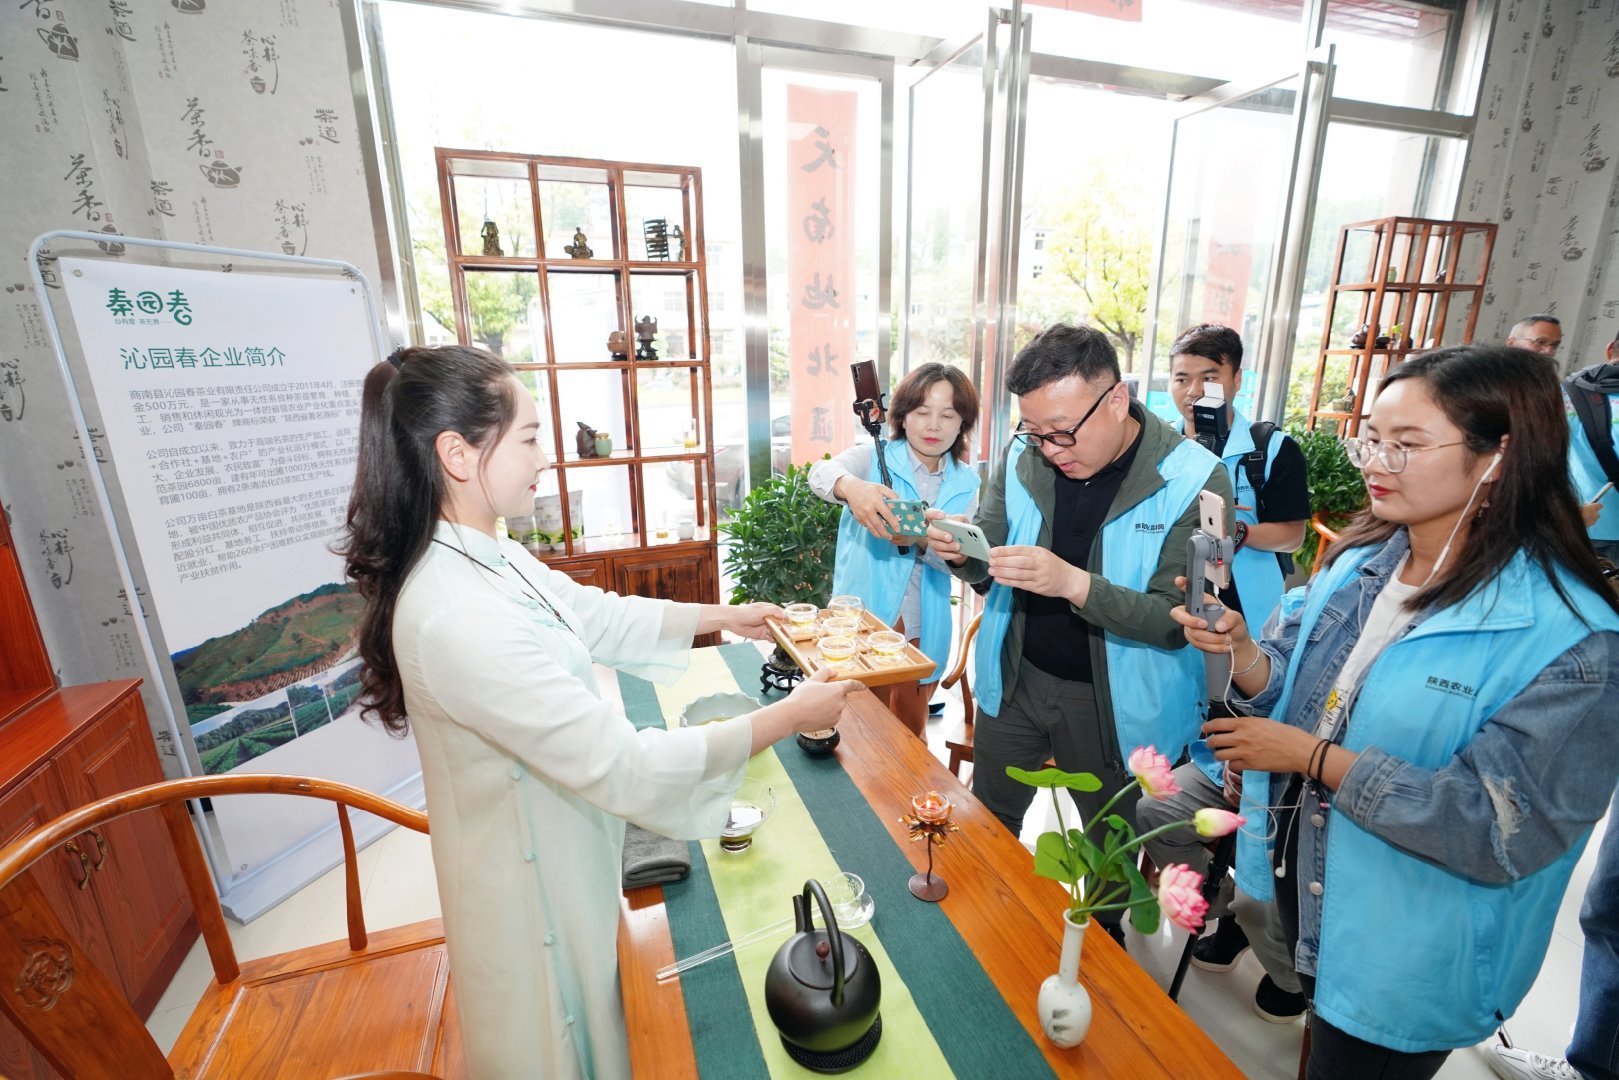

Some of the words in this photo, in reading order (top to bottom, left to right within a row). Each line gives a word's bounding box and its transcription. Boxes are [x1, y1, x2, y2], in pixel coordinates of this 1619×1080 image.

[106, 287, 193, 326] 秦园春
[120, 346, 287, 370] 沁园春企业简介
[1426, 675, 1479, 697] 陕西农业
